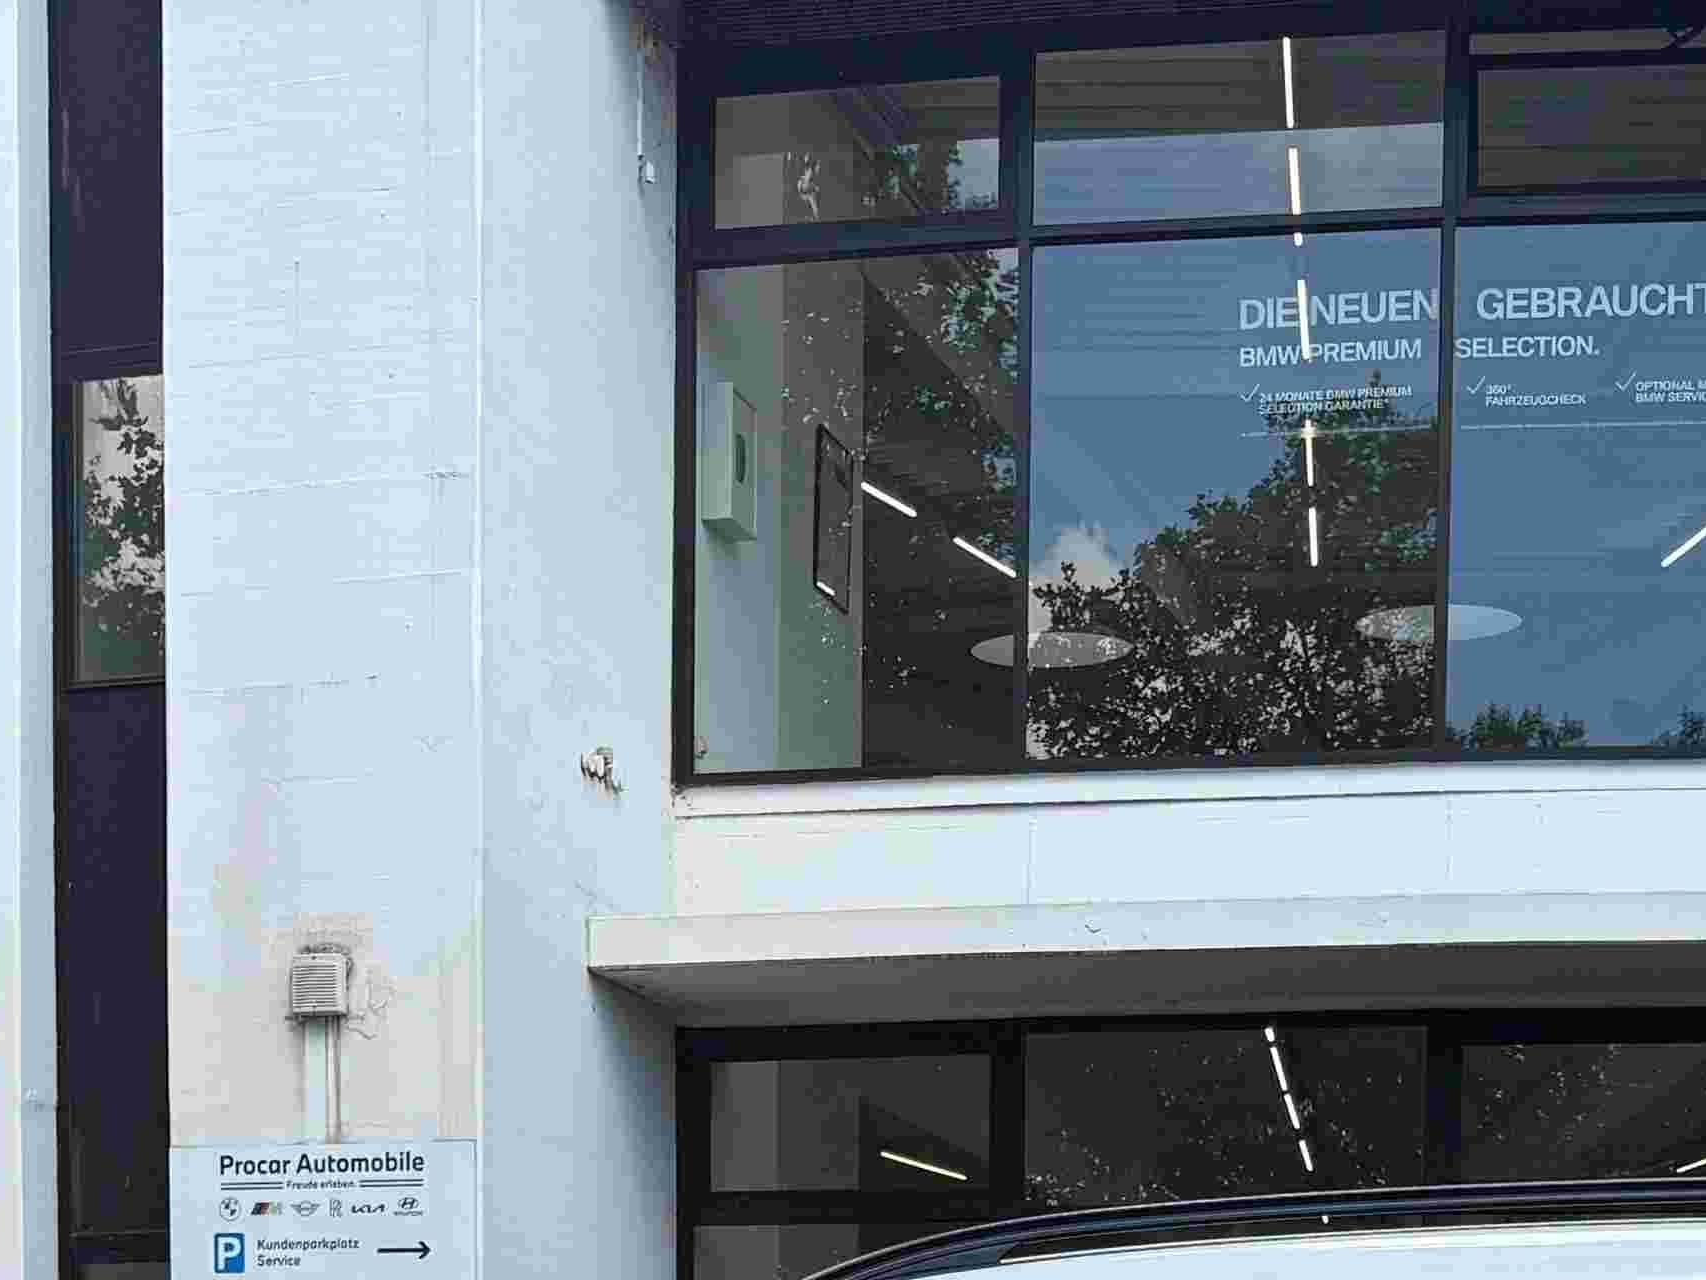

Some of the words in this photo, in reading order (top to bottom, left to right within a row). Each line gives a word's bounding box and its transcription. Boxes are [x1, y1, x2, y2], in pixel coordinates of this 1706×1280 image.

[1239, 295, 1300, 331] DIE
[1310, 288, 1440, 327] NEUEN
[1239, 343, 1301, 368] BMW
[1308, 338, 1423, 364] PREMIUM
[1453, 335, 1601, 360] SELECTION.
[1358, 384, 1413, 399] PREMIUM
[1636, 379, 1695, 392] OPTIONAL
[219, 1154, 292, 1176] Procar
[296, 1150, 426, 1174] Automobile
[256, 1237, 360, 1252] Kundenparkplatz
[256, 1254, 302, 1267] Service
